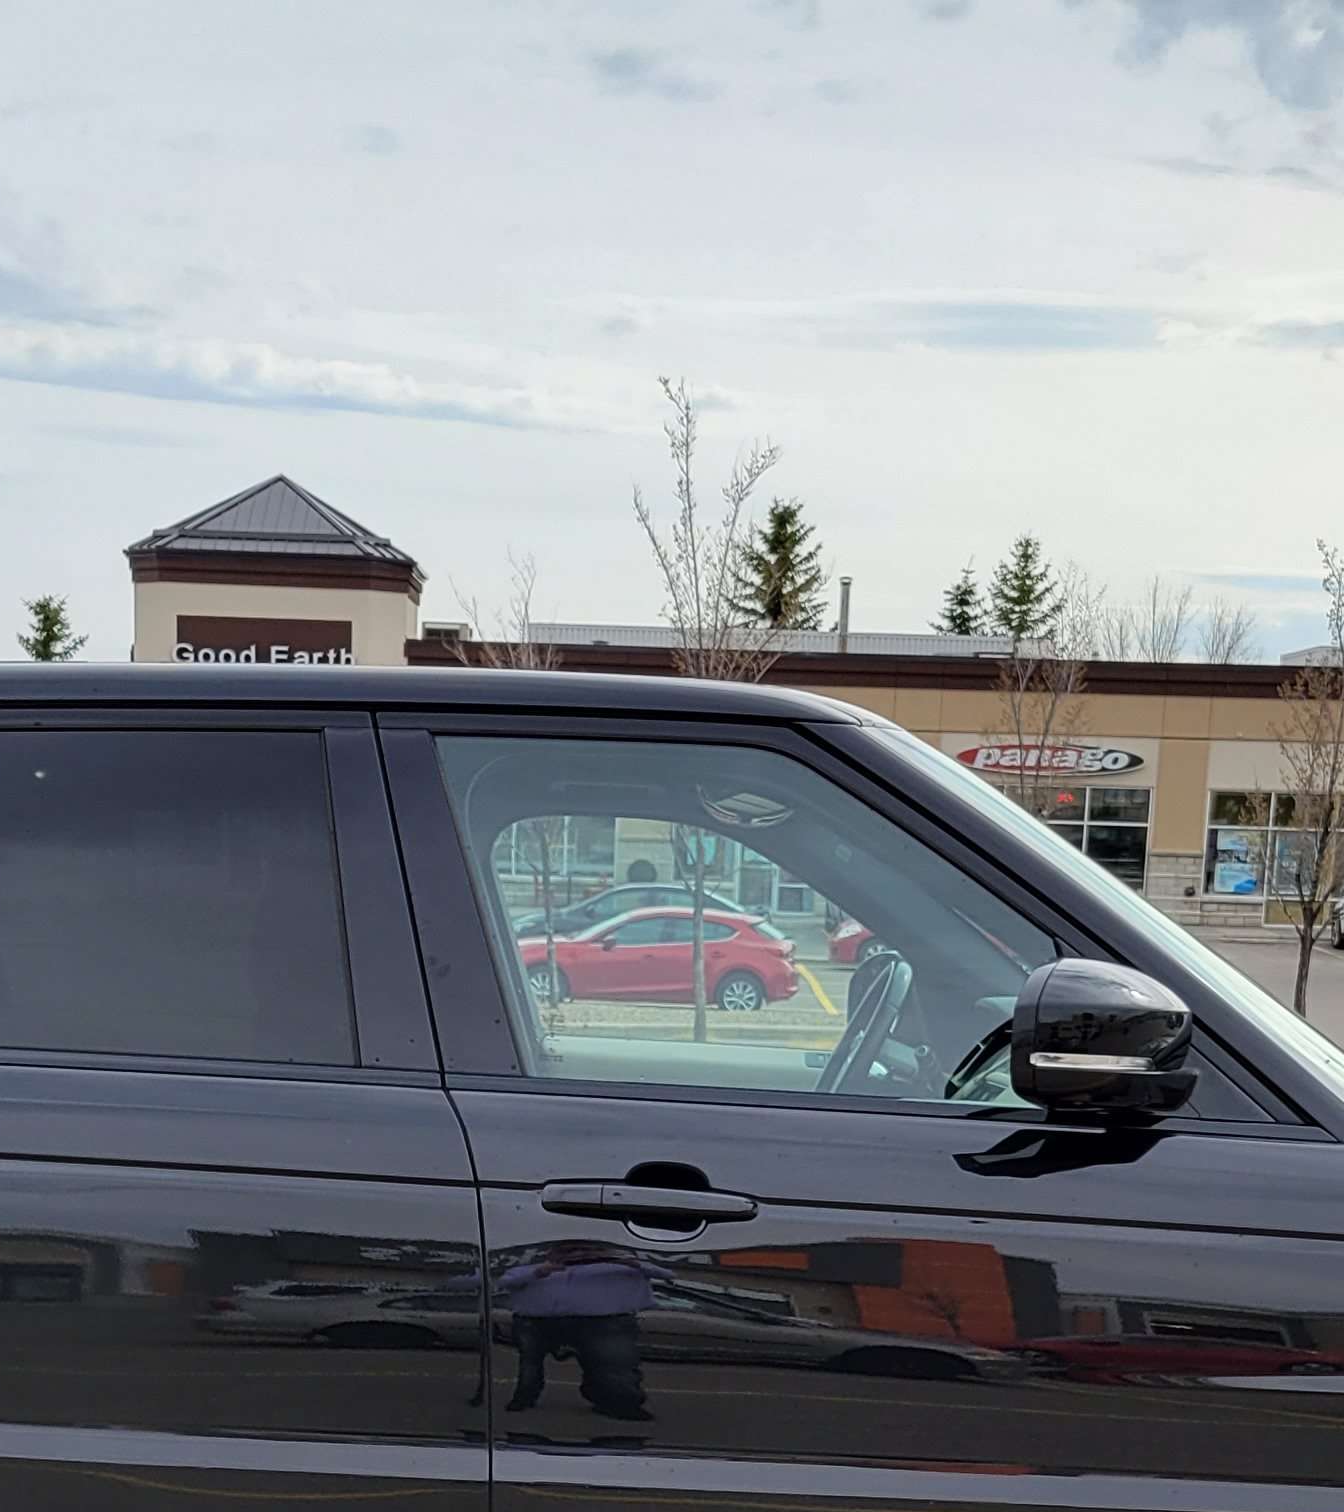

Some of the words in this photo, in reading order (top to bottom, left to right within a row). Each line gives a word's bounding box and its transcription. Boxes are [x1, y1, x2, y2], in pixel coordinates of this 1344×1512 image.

[172, 642, 256, 664] Good
[270, 645, 356, 665] Earth
[974, 747, 1131, 771] panago
